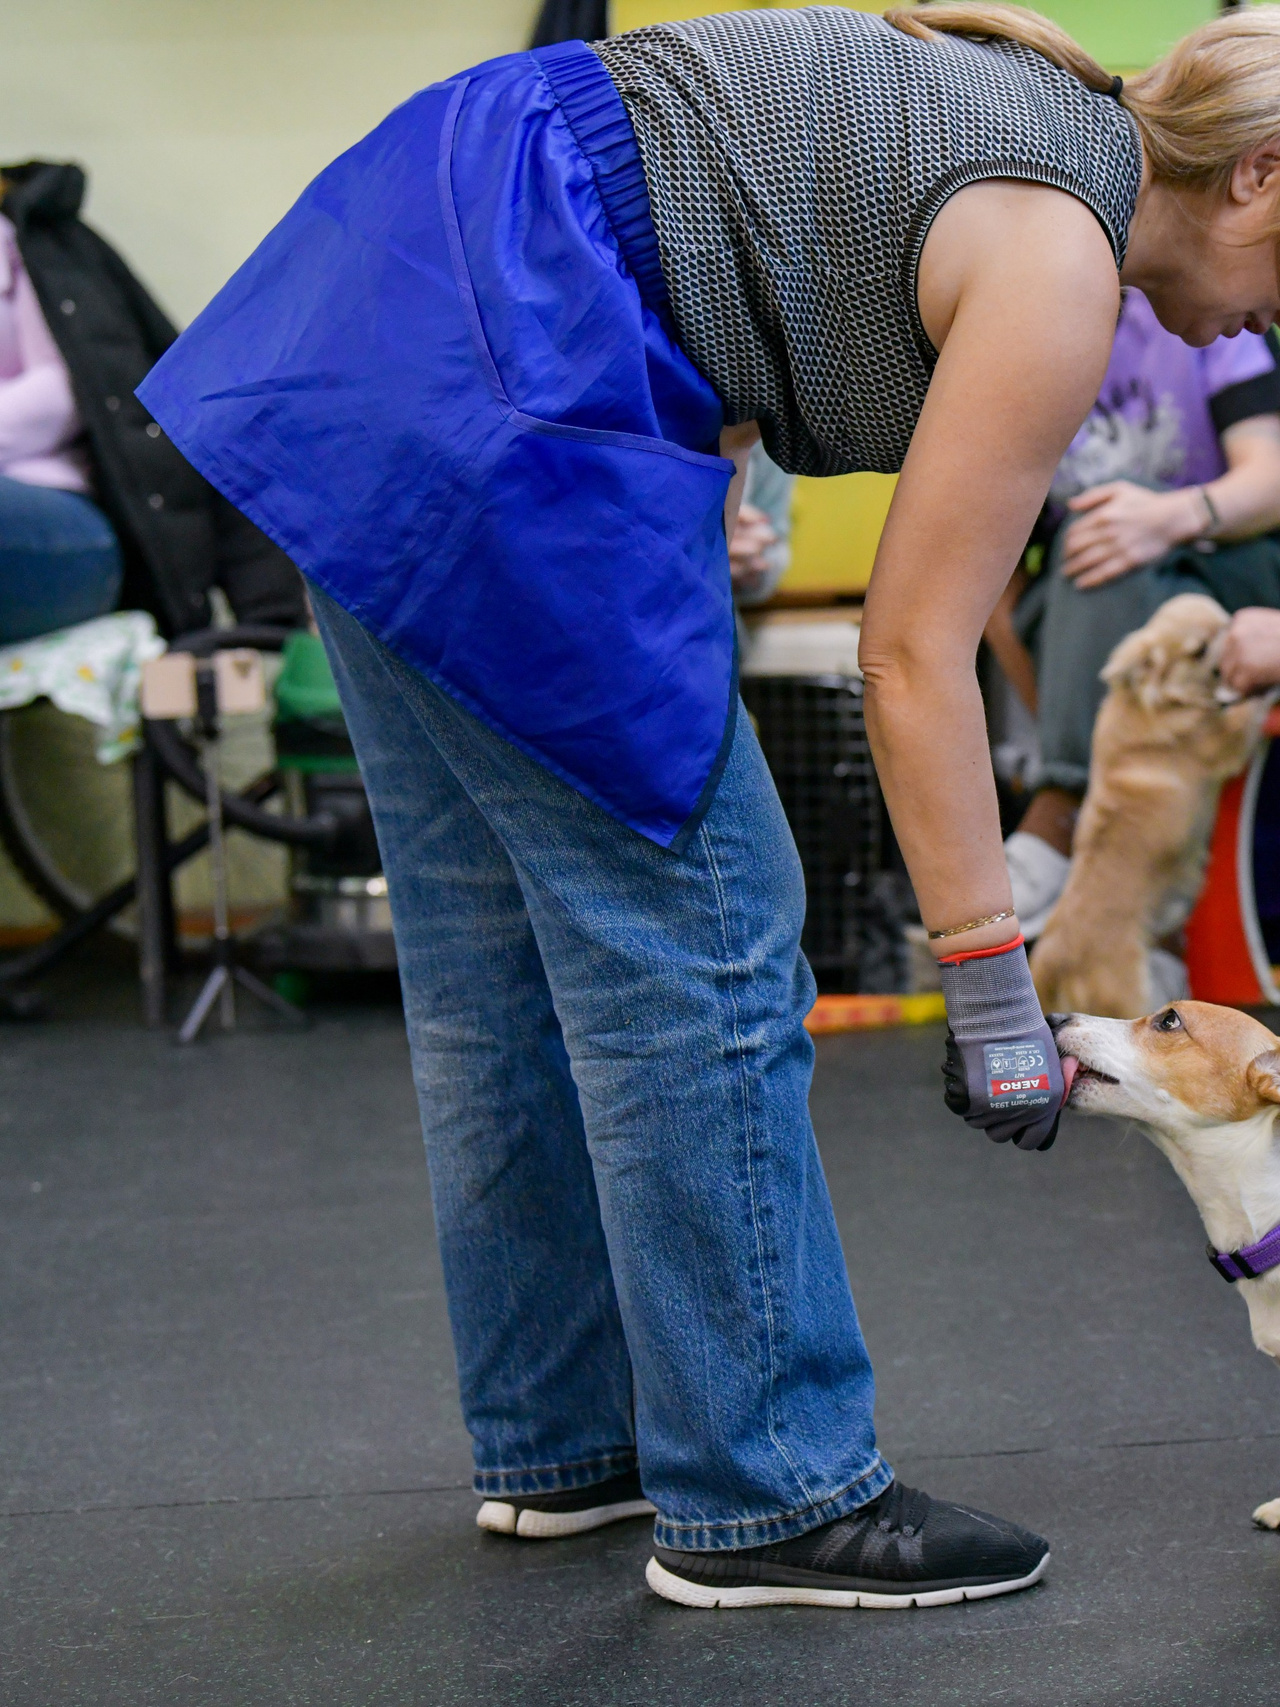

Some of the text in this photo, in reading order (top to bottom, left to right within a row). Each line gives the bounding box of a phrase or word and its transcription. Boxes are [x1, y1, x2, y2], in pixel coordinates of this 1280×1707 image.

[1000, 1079, 1040, 1091] AERO
[990, 1097, 1050, 1109] NipoFoam 1934
